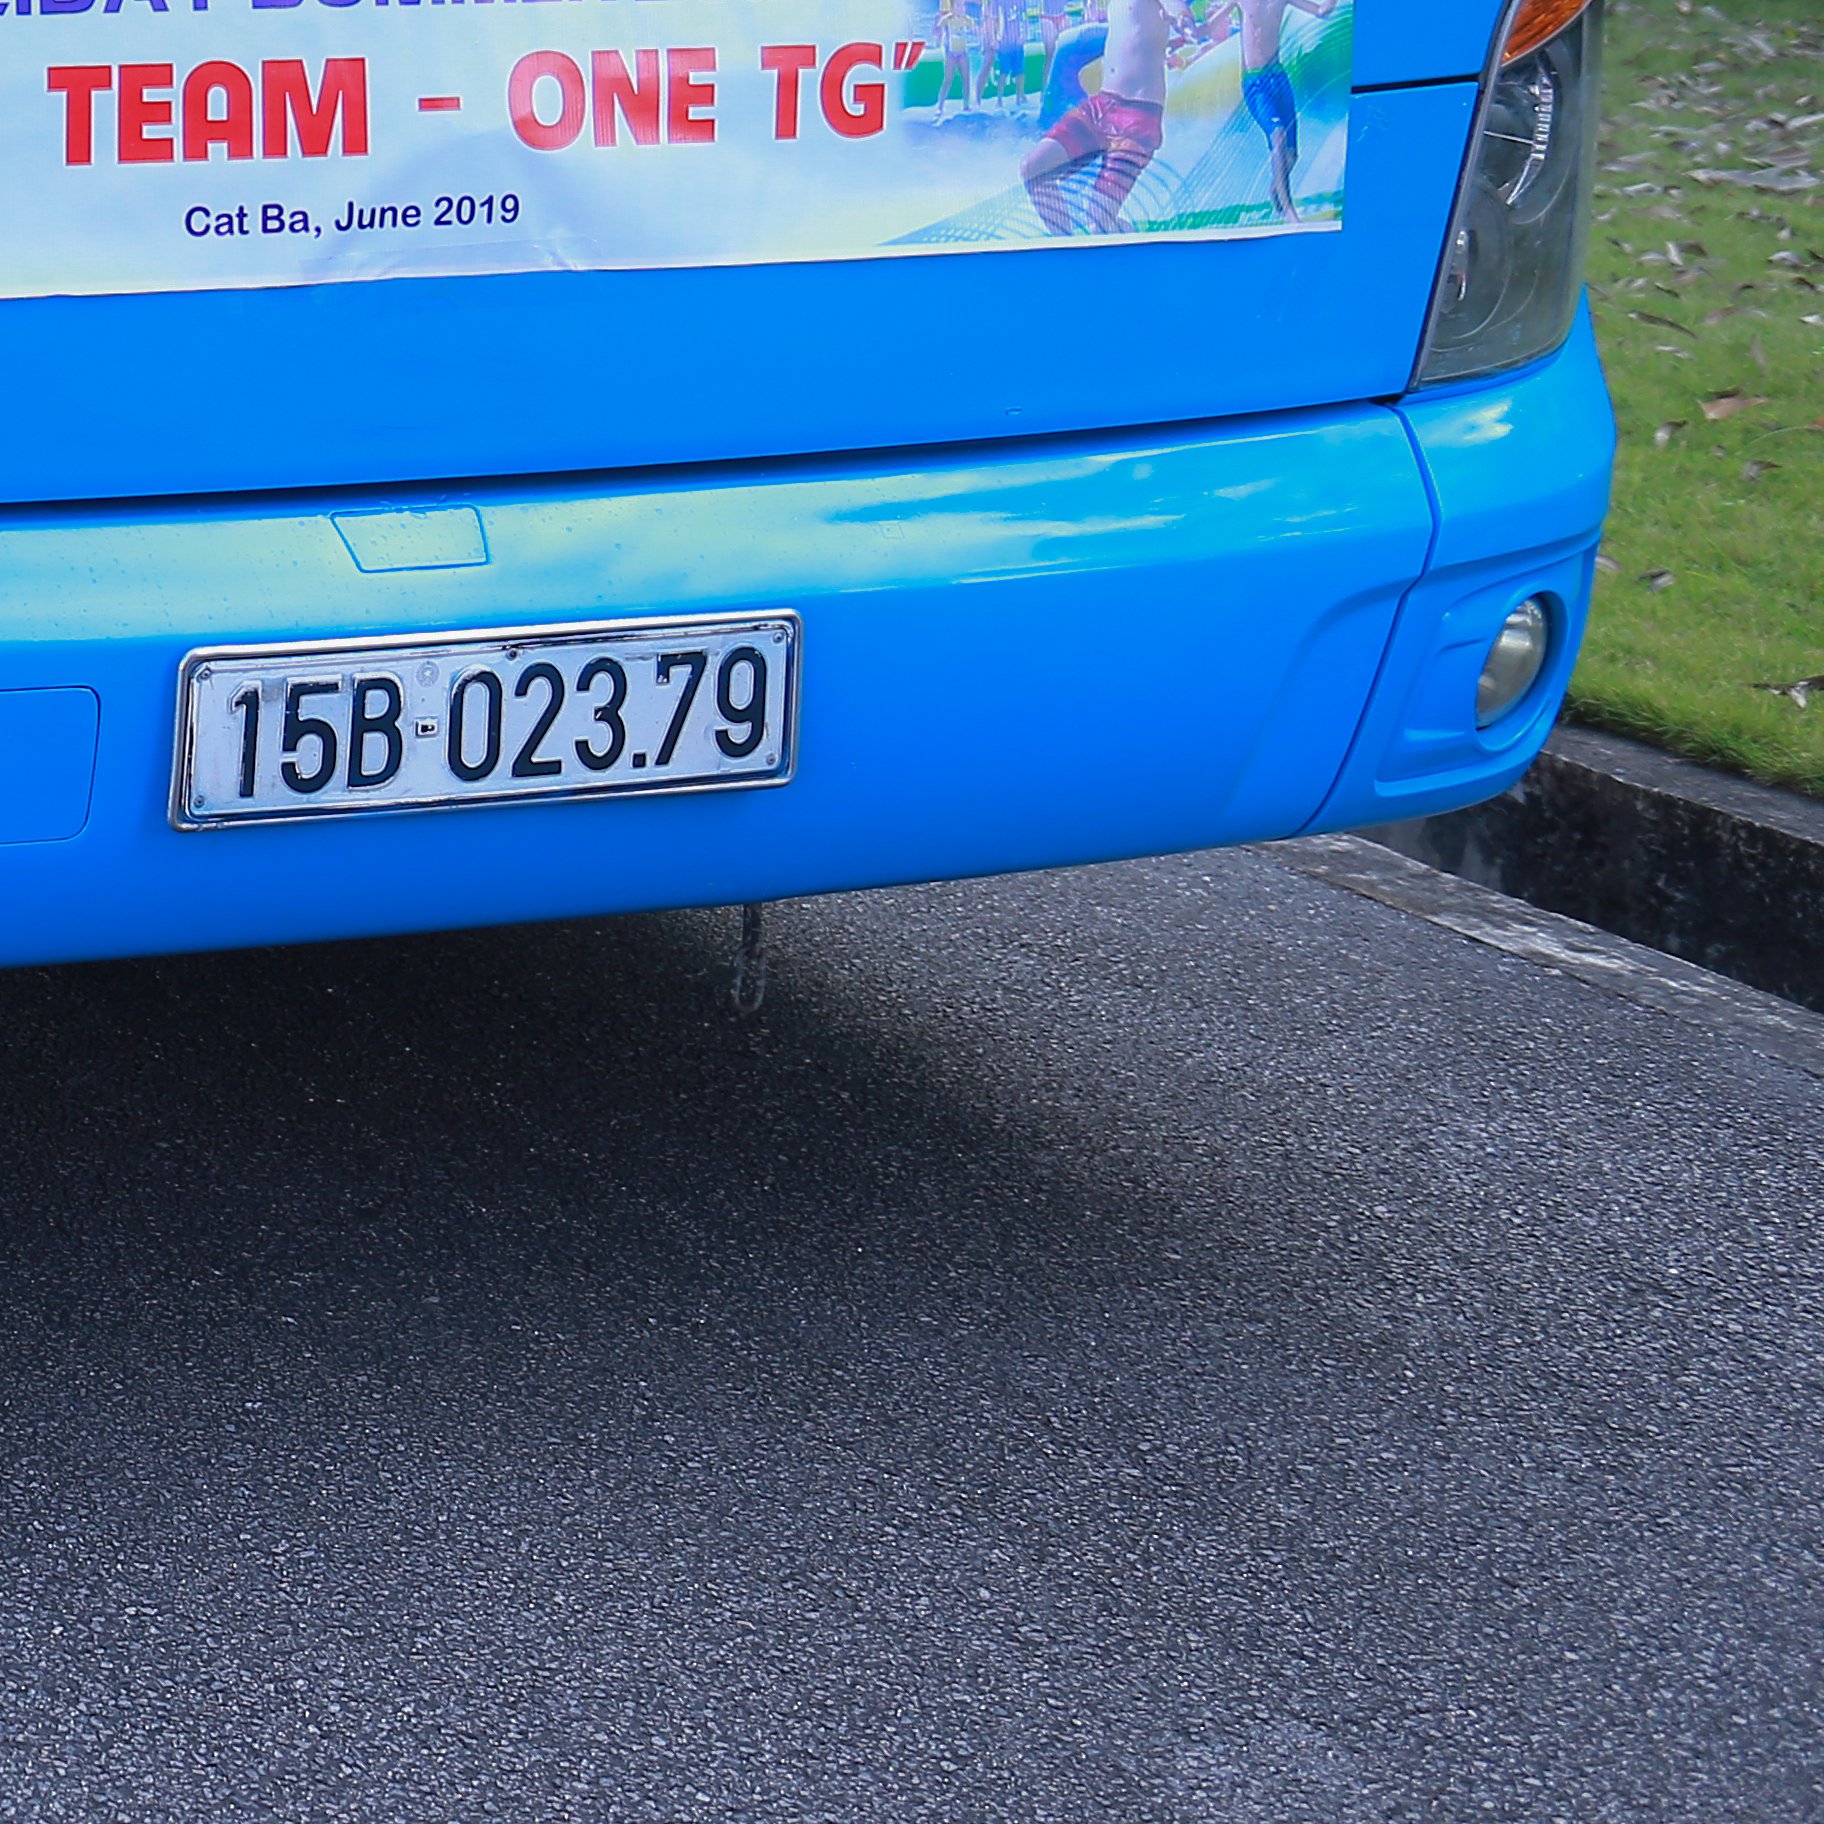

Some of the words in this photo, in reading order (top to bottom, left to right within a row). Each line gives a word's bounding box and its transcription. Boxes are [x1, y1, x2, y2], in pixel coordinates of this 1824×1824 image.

[45, 55, 371, 169] TEAM
[504, 44, 718, 154] ONE
[183, 203, 250, 239] Cat
[258, 202, 324, 242] Ba,
[334, 198, 423, 234] June
[431, 192, 522, 229] 2019
